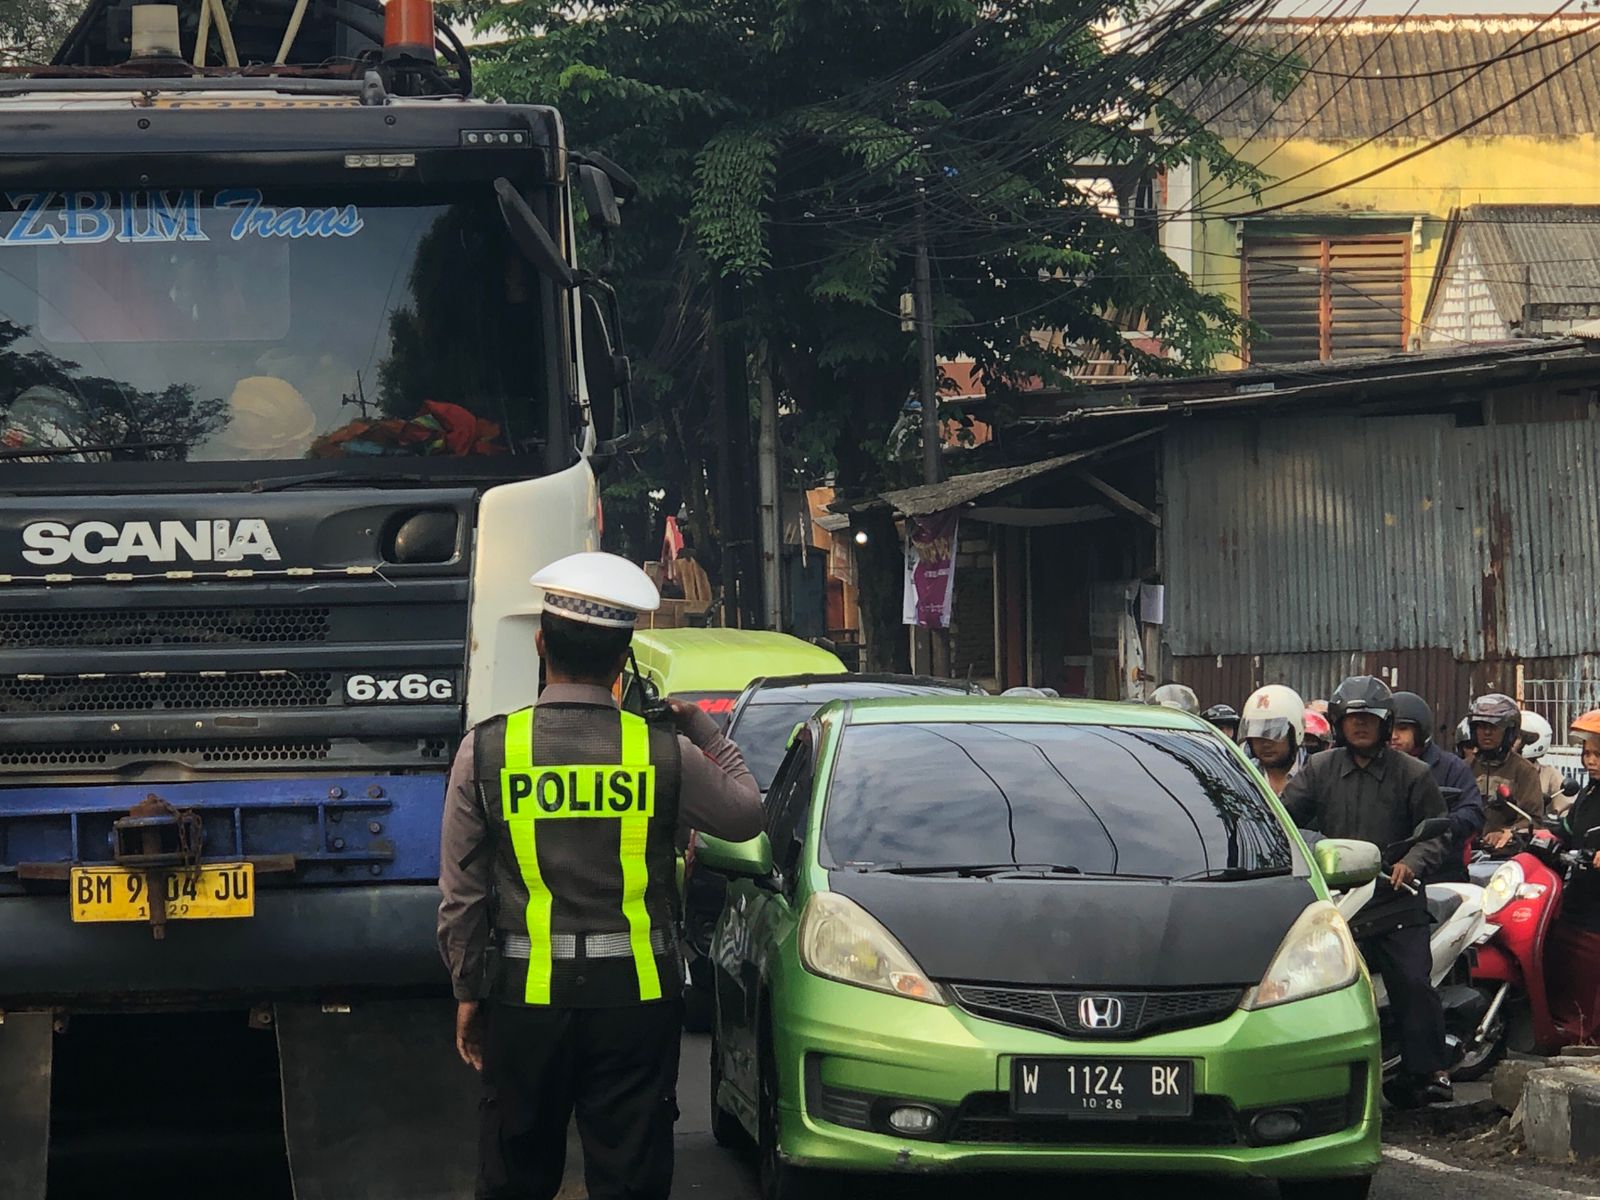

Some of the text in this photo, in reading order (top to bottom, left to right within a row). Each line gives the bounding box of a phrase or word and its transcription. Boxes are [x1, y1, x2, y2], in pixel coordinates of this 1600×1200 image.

[0, 189, 364, 246] ZBIM Trans
[21, 519, 281, 565] SCANIA
[346, 673, 453, 700] 6x6G
[508, 770, 647, 814] POLISI
[77, 871, 249, 904] BM 904 JU
[1022, 1064, 1180, 1096] W 1124 BK
